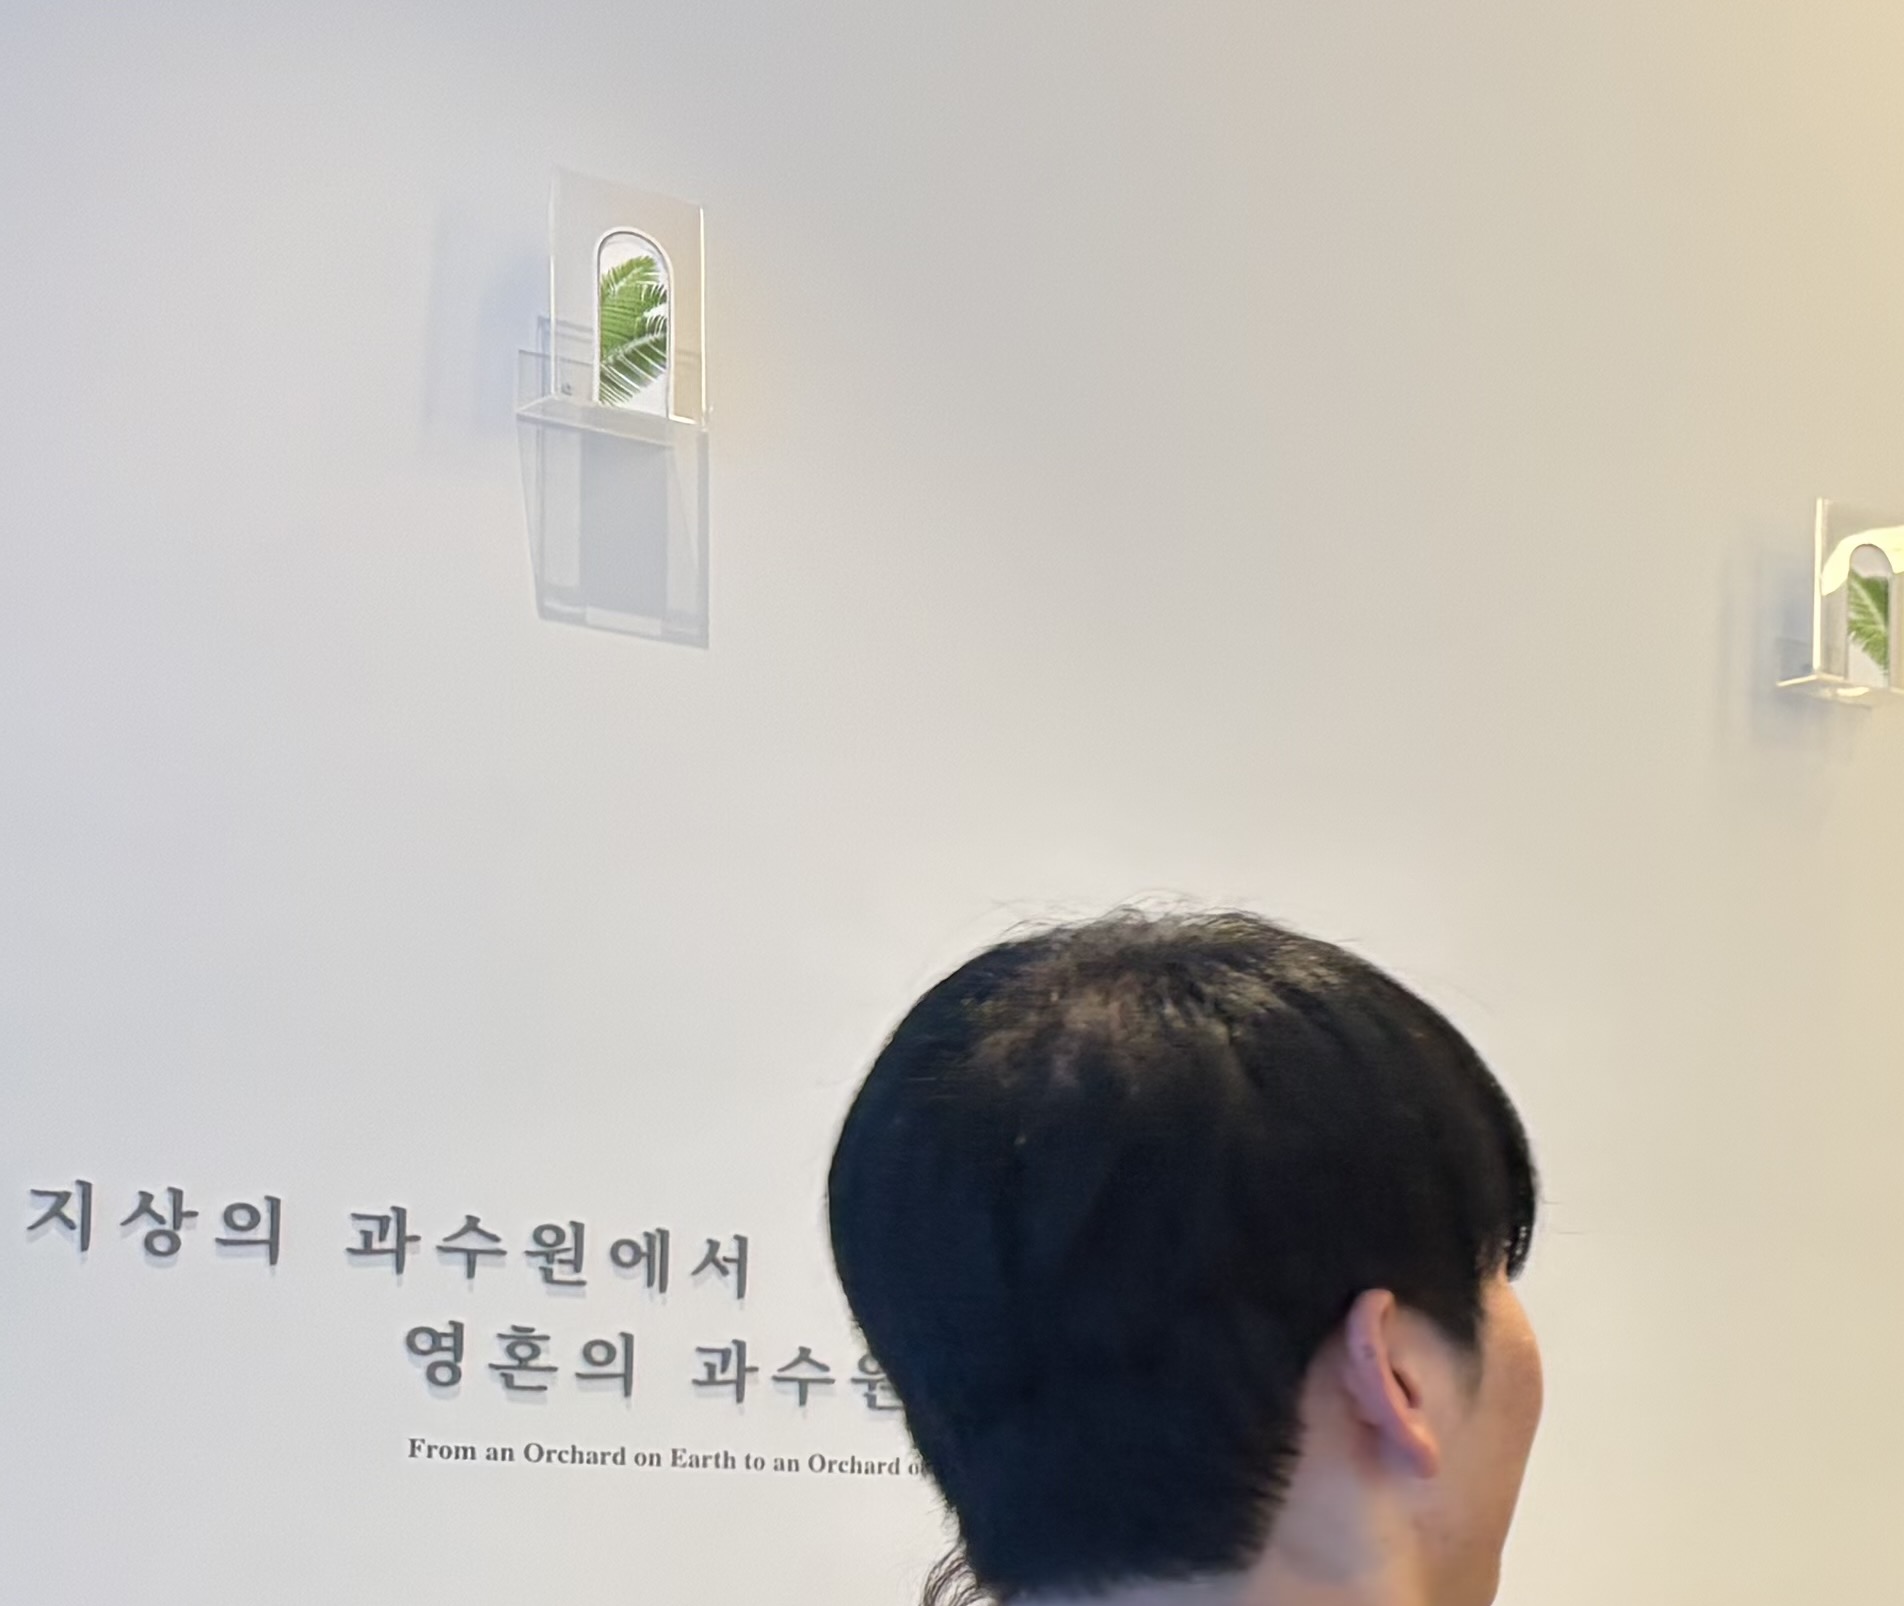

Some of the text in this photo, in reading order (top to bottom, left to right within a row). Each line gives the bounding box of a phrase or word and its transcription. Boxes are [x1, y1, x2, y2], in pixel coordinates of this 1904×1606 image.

[27, 1179, 748, 1300] 지상의 과수원에서
[406, 1320, 634, 1398] 영혼의
[408, 1438, 477, 1462] From
[484, 1446, 516, 1462] an
[523, 1442, 626, 1466] Orchard
[634, 1450, 662, 1467] on
[671, 1448, 736, 1470] Earth
[745, 1452, 766, 1471] to
[773, 1456, 800, 1472] an
[808, 1453, 900, 1475] Orchard
